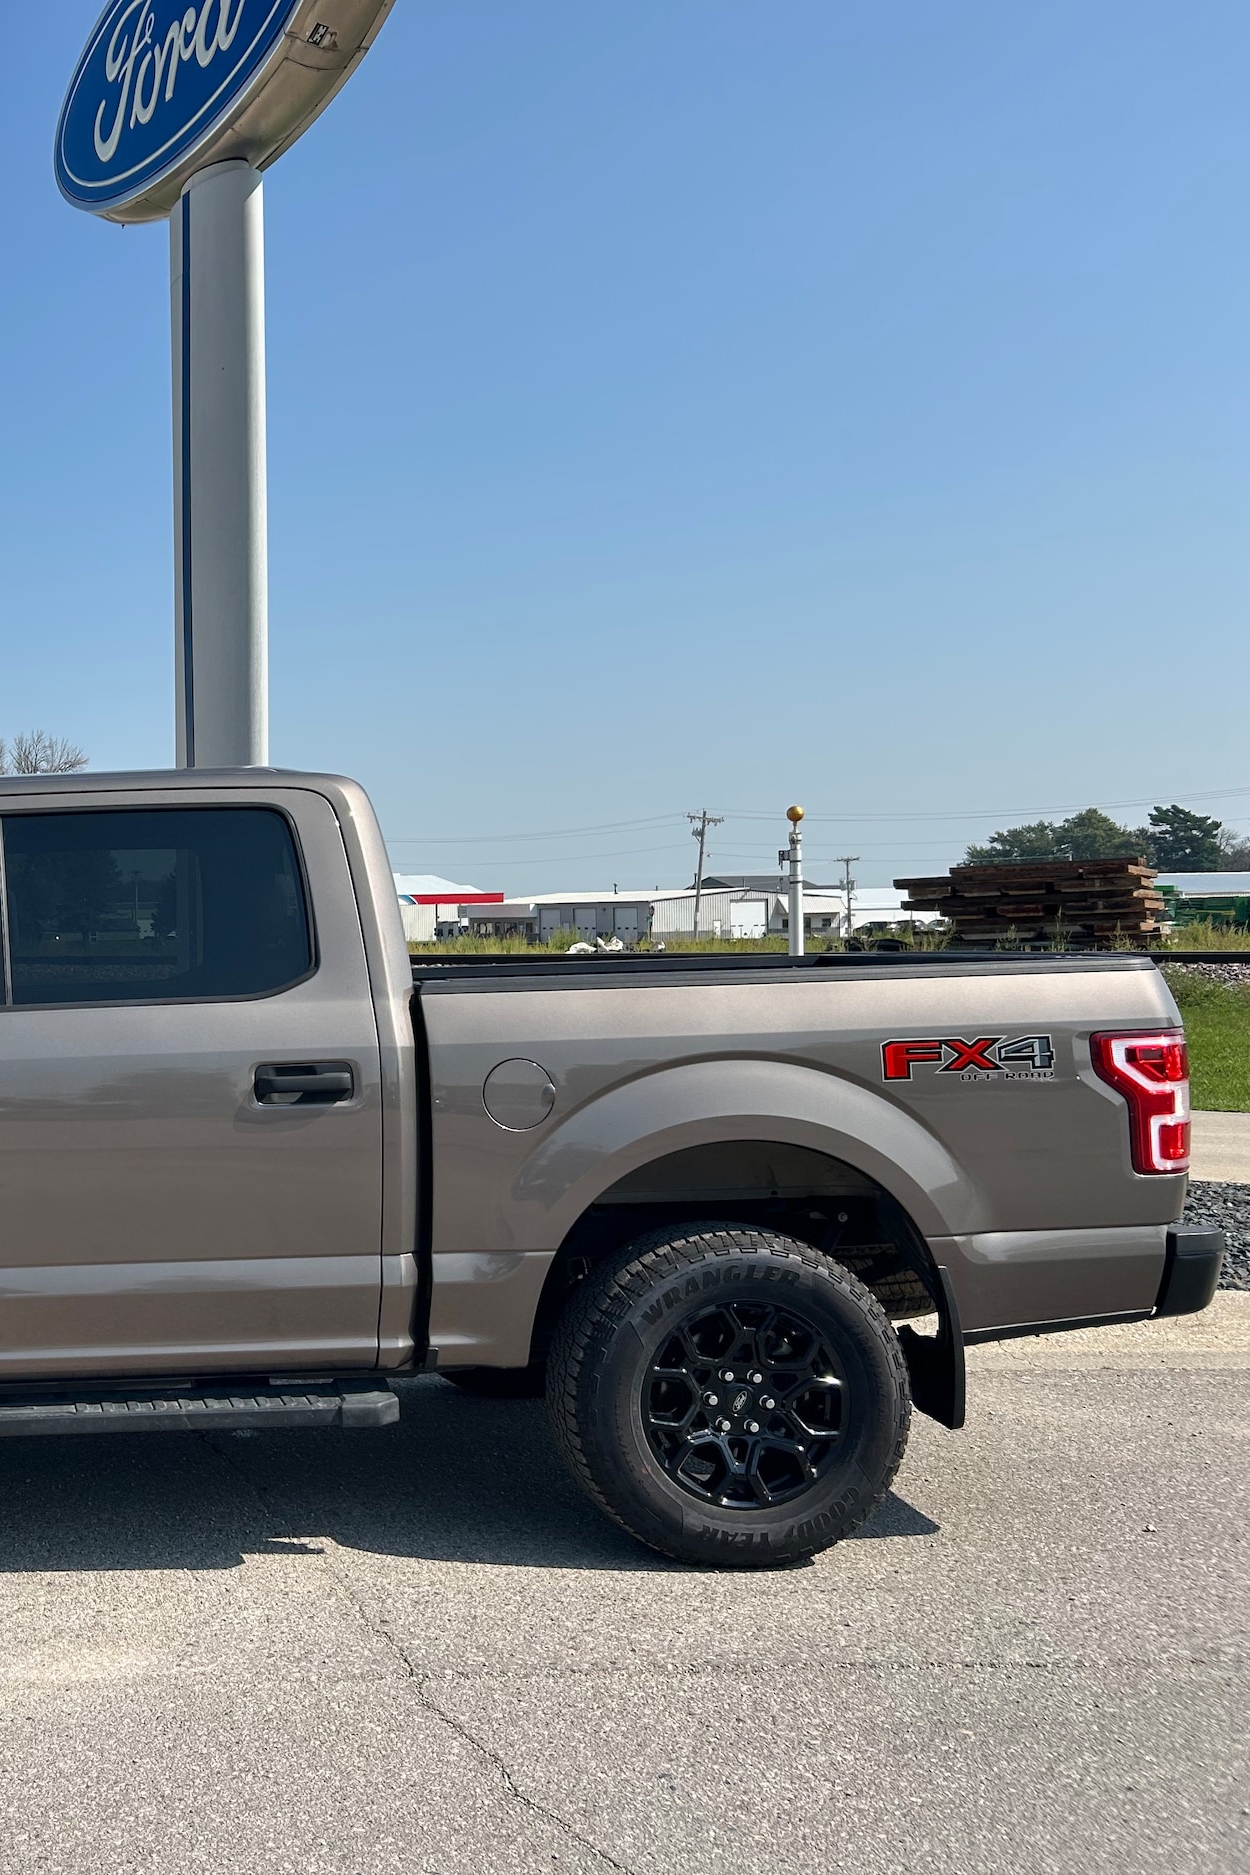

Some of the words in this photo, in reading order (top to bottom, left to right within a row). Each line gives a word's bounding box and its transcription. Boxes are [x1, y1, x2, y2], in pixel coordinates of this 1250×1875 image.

[94, 0, 246, 162] Ford
[880, 1034, 1056, 1082] FX4
[960, 1073, 998, 1081] OFF
[1004, 1071, 1055, 1080] ROAD
[640, 1264, 801, 1326] WRANGLER
